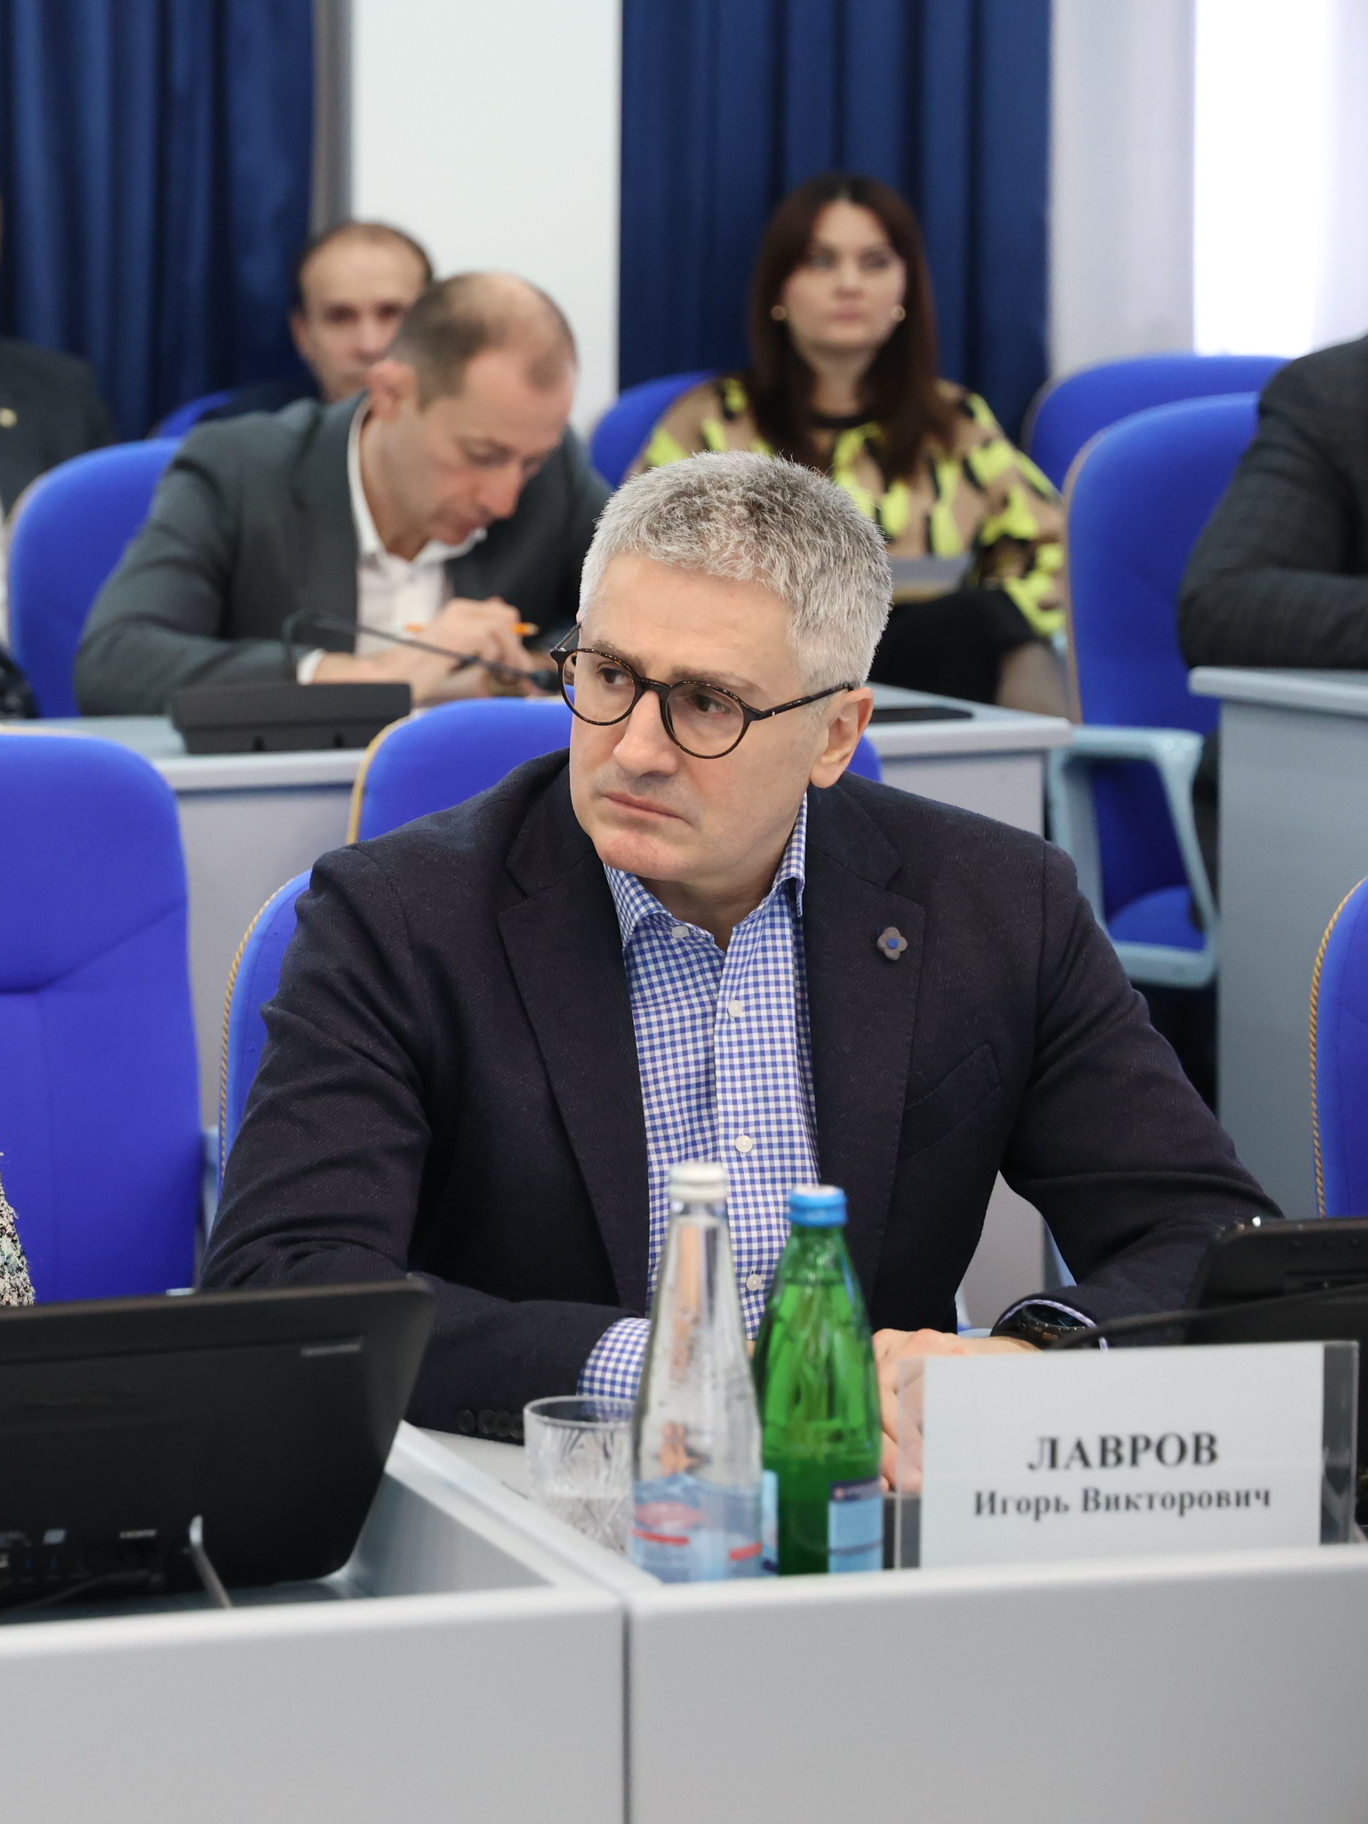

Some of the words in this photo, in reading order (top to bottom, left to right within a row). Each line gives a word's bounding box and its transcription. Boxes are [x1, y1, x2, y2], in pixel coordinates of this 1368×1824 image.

[1026, 1431, 1219, 1471] ЛАВРОВ
[973, 1489, 1070, 1522] Игорь
[1081, 1486, 1272, 1518] Викторович
